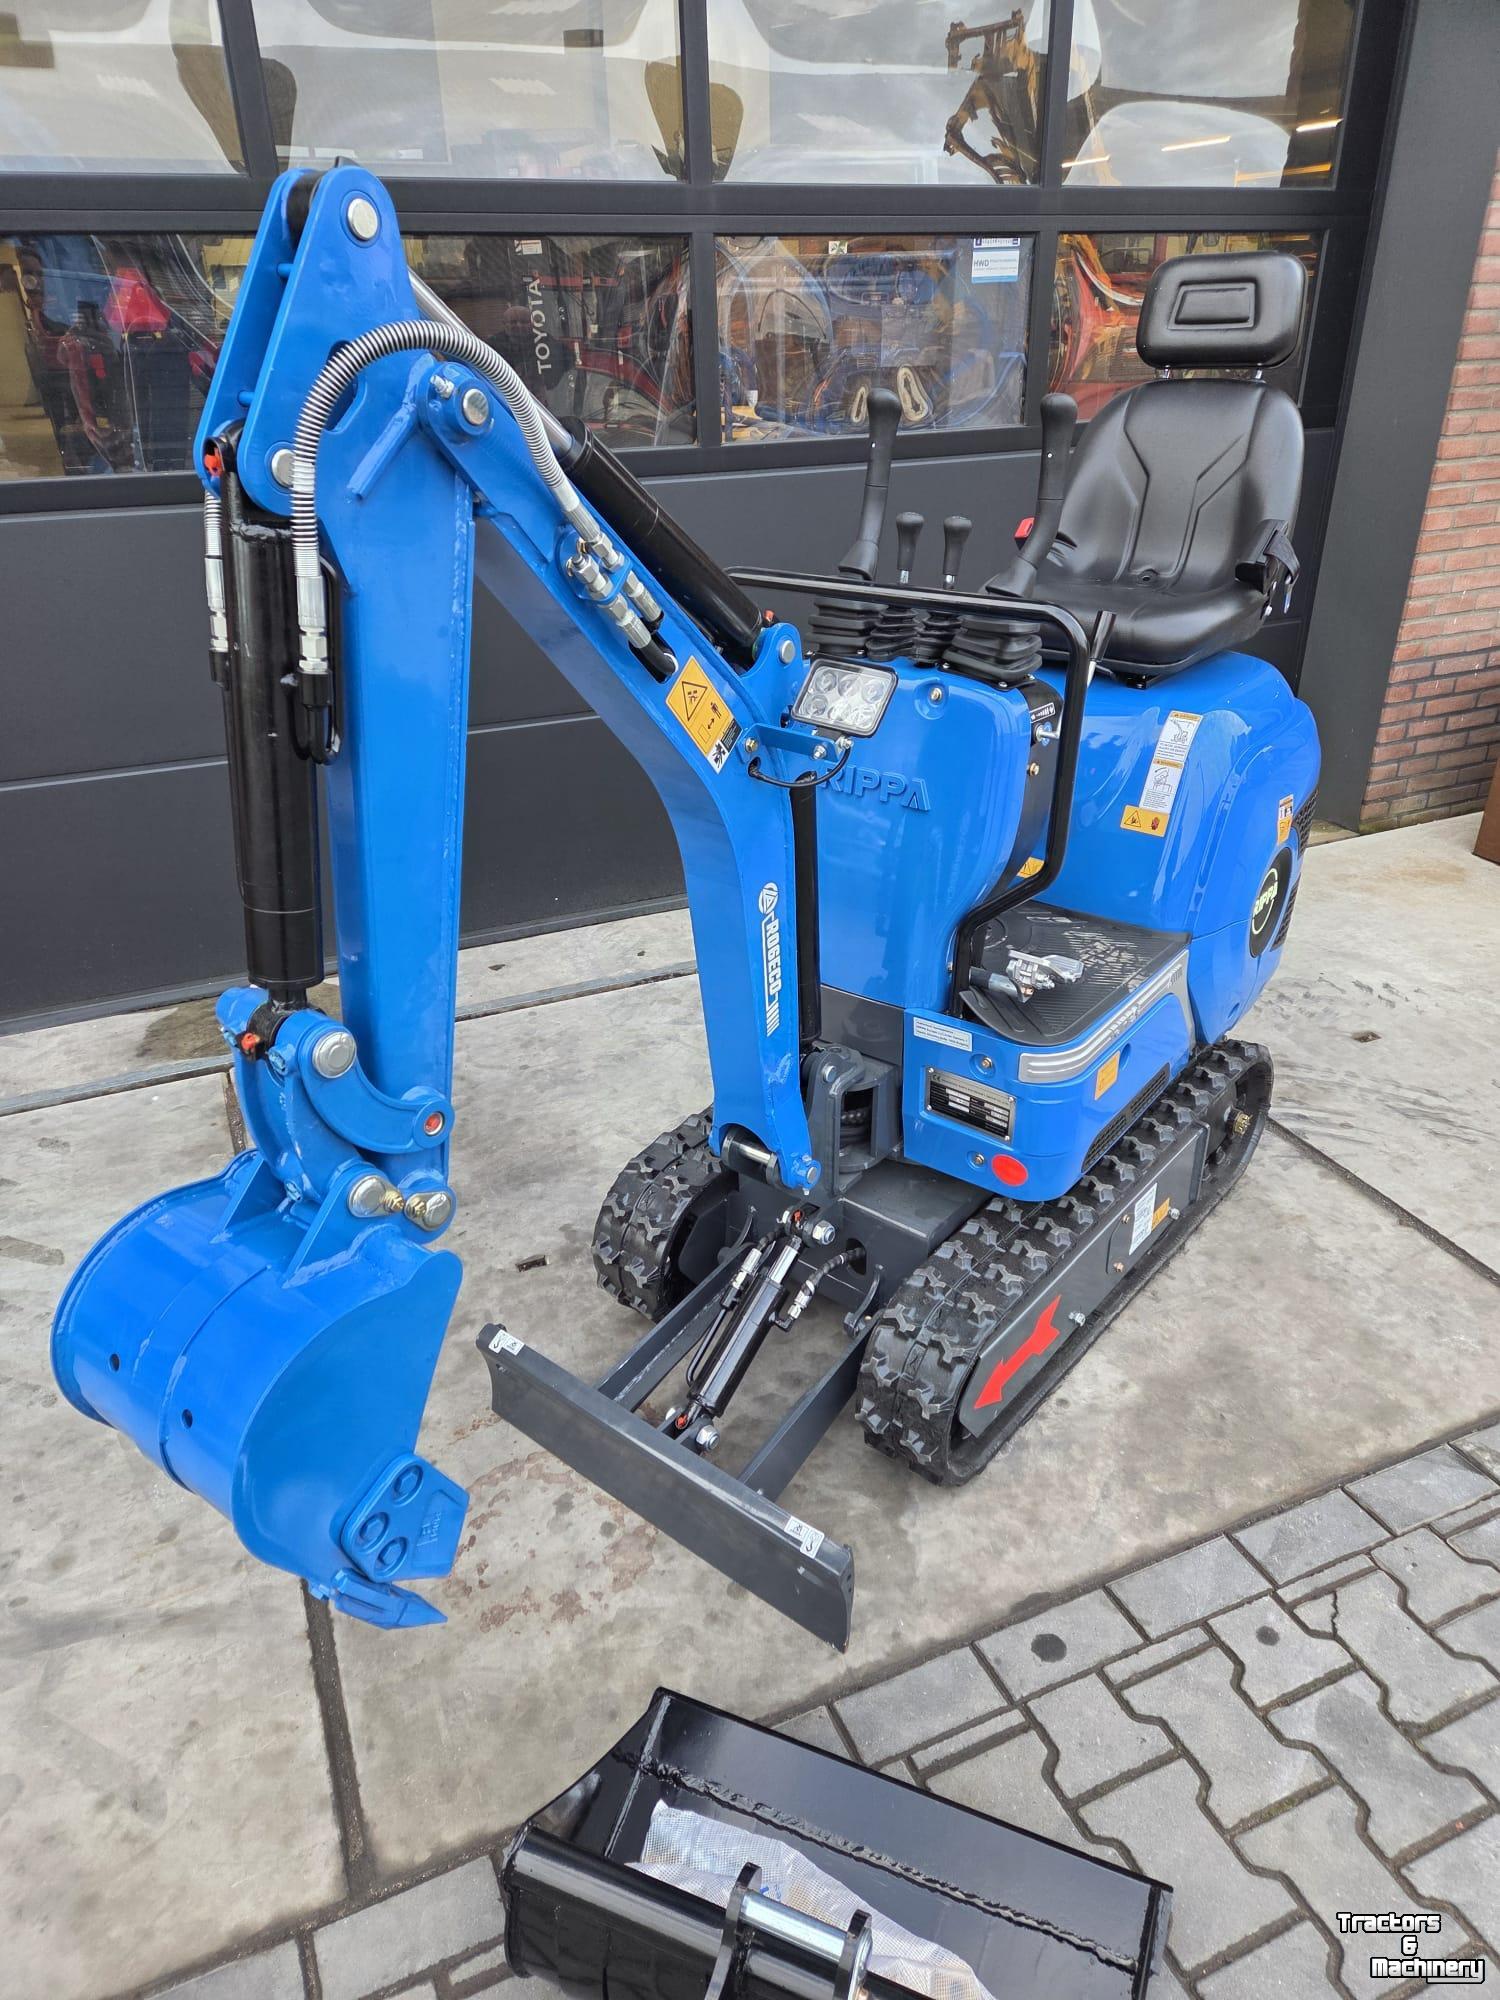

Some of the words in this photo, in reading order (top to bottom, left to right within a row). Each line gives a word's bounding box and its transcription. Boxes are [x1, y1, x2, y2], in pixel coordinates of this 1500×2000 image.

[528, 278, 552, 375] TOYOTA
[820, 761, 931, 811] RIPPA
[765, 917, 783, 996] ROGECO
